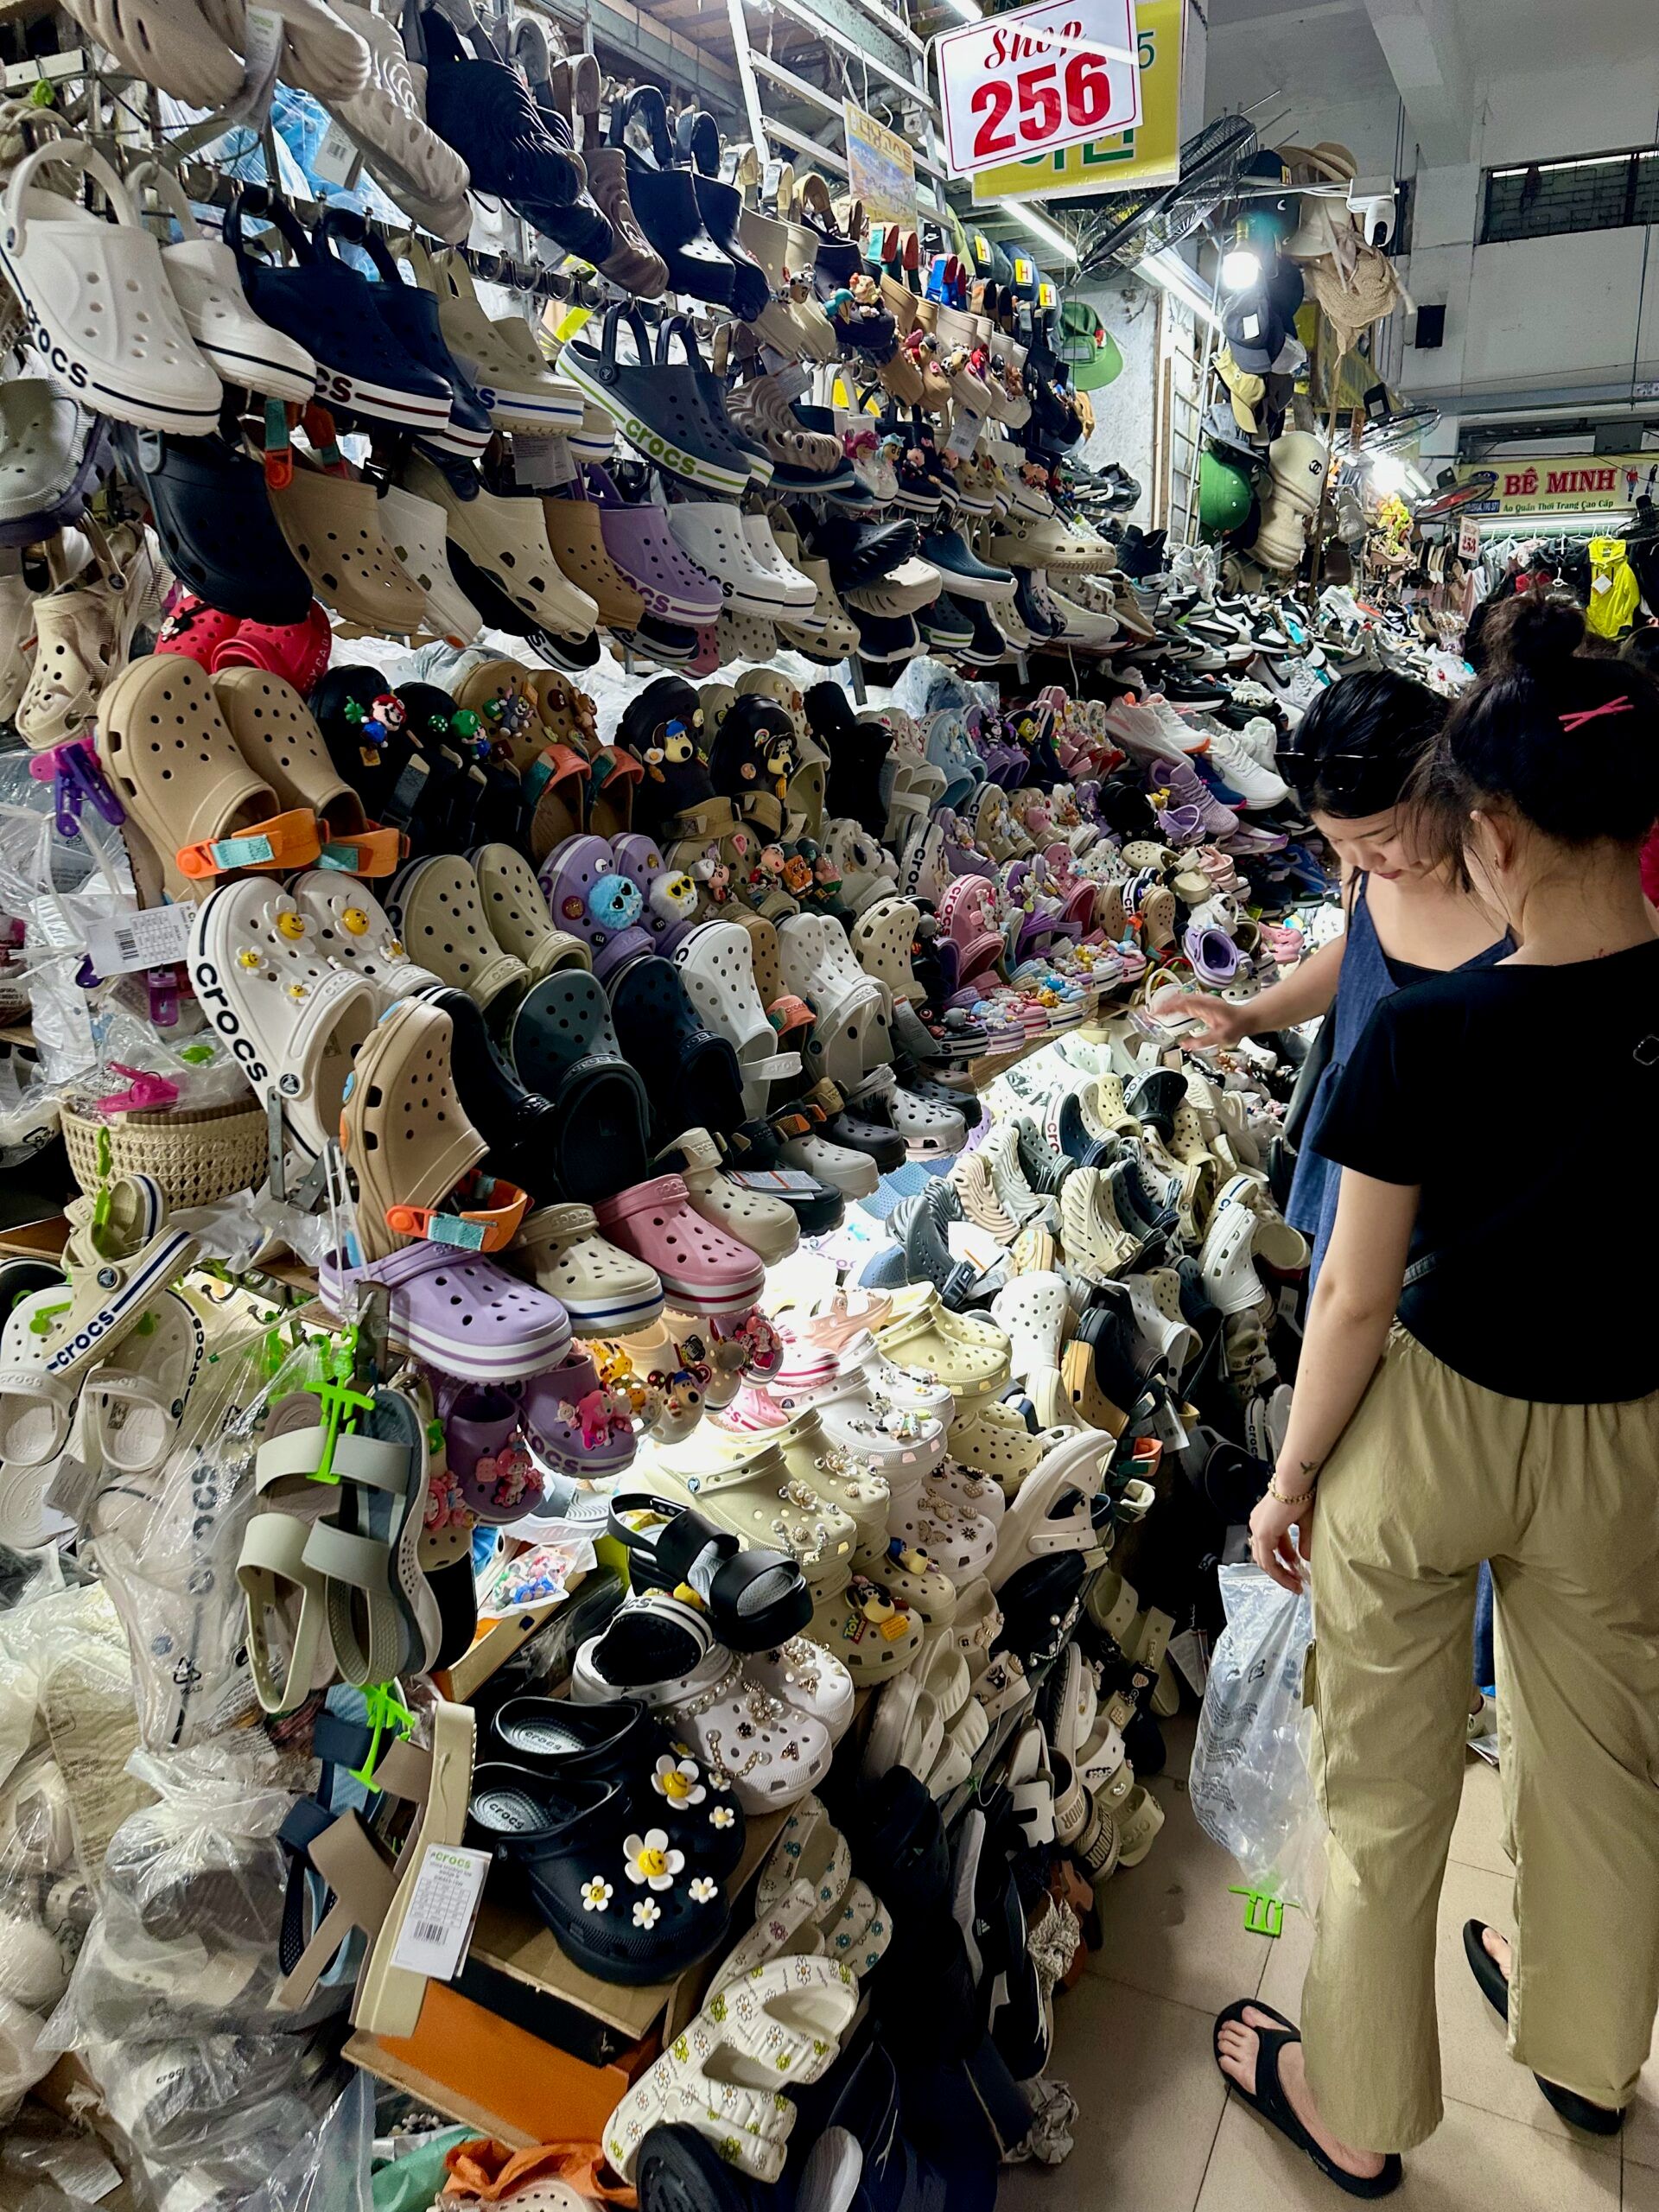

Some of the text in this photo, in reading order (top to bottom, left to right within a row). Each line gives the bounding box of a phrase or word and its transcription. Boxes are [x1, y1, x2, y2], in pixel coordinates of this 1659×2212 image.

[971, 52, 1110, 157] 256
[1021, 266, 1029, 280] H
[1044, 291, 1052, 302] H
[626, 419, 696, 476] crocs
[1503, 467, 1618, 497] BÊ MINH
[1556, 500, 1580, 511] Trang
[1581, 499, 1597, 510] Cao
[196, 963, 269, 1083] crocs
[56, 1308, 116, 1367] crocs
[188, 1318, 206, 1387] crocs
[843, 1614, 859, 1637] TOY
[524, 1731, 563, 1751] crocs
[1086, 1766, 1113, 1778] crocs
[489, 1802, 525, 1830] crocs
[435, 1851, 472, 1870] crocs
